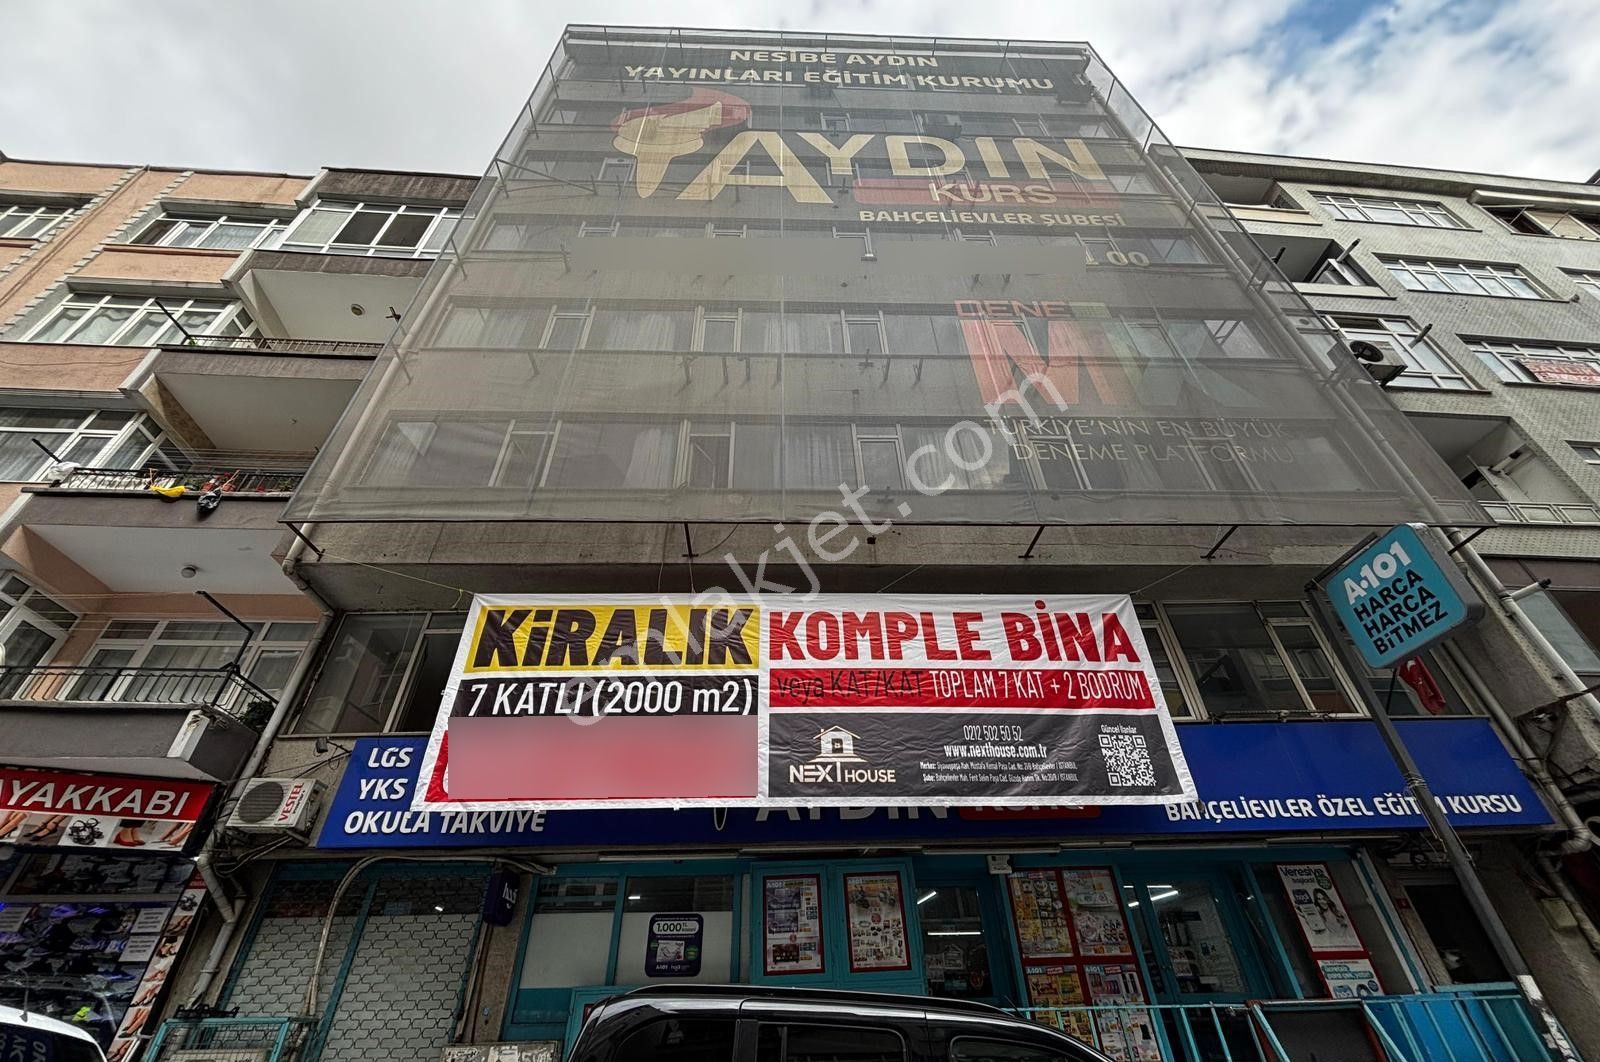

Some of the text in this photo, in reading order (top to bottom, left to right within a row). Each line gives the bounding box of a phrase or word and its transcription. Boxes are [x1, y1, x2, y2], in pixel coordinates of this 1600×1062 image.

[730, 48, 939, 68] NESİBE AYDIN
[624, 64, 1054, 90] YAYINLARI EĞİTİM KURUMU
[676, 129, 1107, 204] AYDIN
[929, 179, 1058, 204] KURS
[859, 209, 1126, 227] BAHÇELİEVLER ŞUBESİ
[983, 414, 1290, 439] TÜRKİYE'NİN EN BÜYÜK
[1015, 443, 1296, 464] DENEME PLATFORMU
[1353, 569, 1424, 623] HARCA
[1362, 586, 1436, 639] HARCA
[473, 608, 753, 668] KİRALIK
[769, 600, 1141, 663] KOMPLE BİNA
[467, 678, 753, 717] 7 KATLI (2000 m2)
[777, 676, 825, 706] veya
[829, 669, 923, 699] KAT/KAT
[928, 669, 999, 699] TOPLAM
[998, 670, 1009, 699] 7
[1014, 670, 1046, 700] KAT
[1063, 671, 1077, 701] 2
[1079, 670, 1145, 701] BODRUM
[963, 724, 1024, 742] 0212 502 50 52
[368, 746, 414, 768] LGS
[944, 742, 1047, 758] www.nexthouse.com.tr
[789, 761, 896, 783] NEXT HOUSE
[359, 777, 409, 801] YKS
[278, 782, 305, 822] VESTEL
[1317, 795, 1373, 817] ÖZEL
[1446, 794, 1523, 814] KURSU
[344, 810, 430, 834] OKULA
